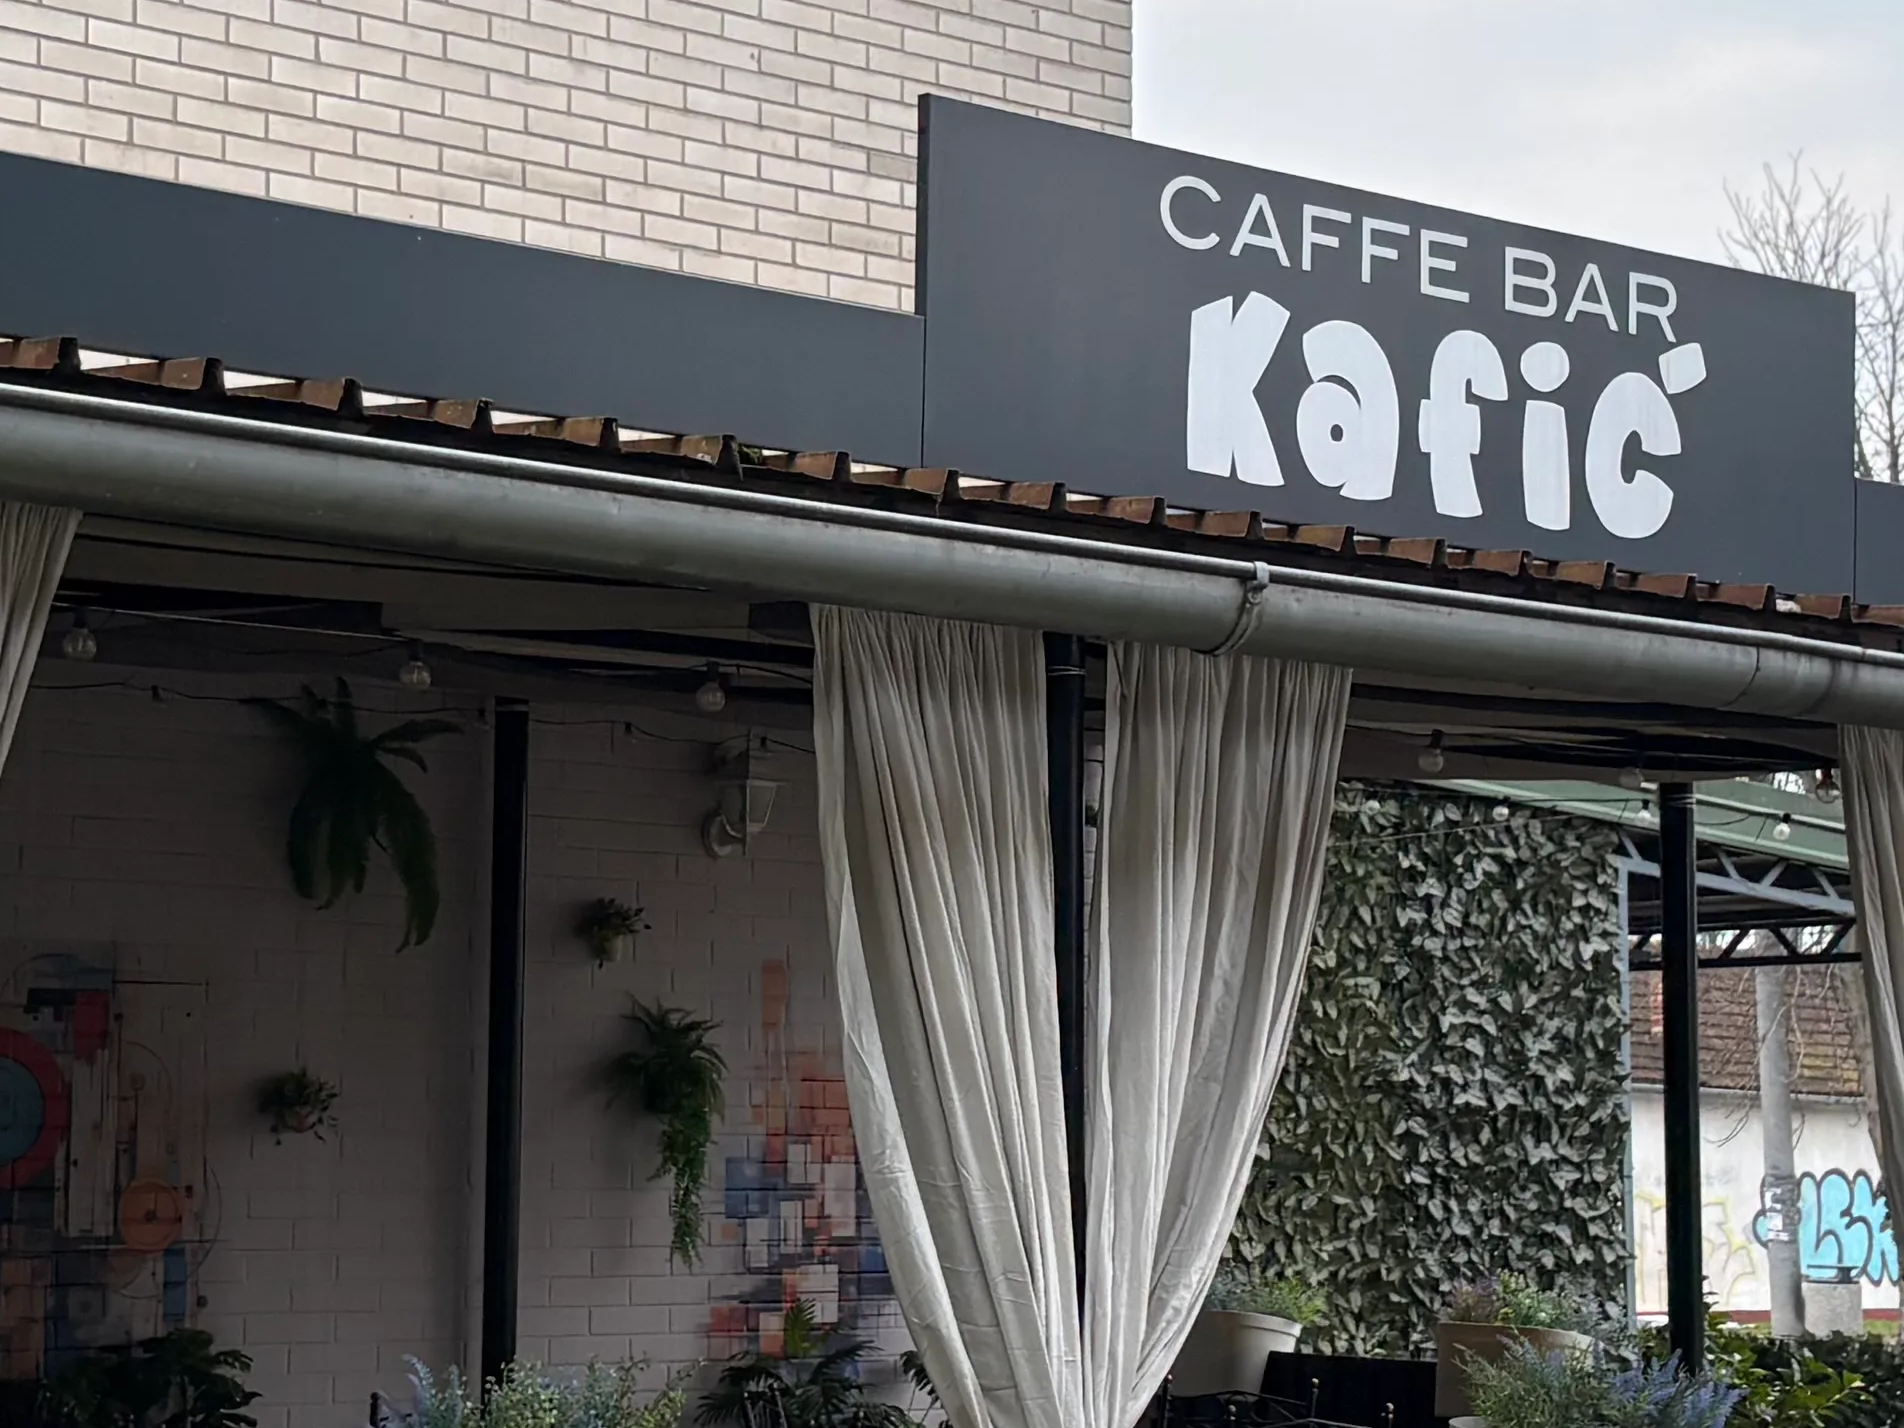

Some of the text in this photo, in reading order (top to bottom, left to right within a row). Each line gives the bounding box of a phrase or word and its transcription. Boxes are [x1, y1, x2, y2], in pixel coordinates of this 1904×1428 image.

[1159, 174, 1678, 343] CAFFE BAR
[1186, 290, 1708, 539] Kafić
